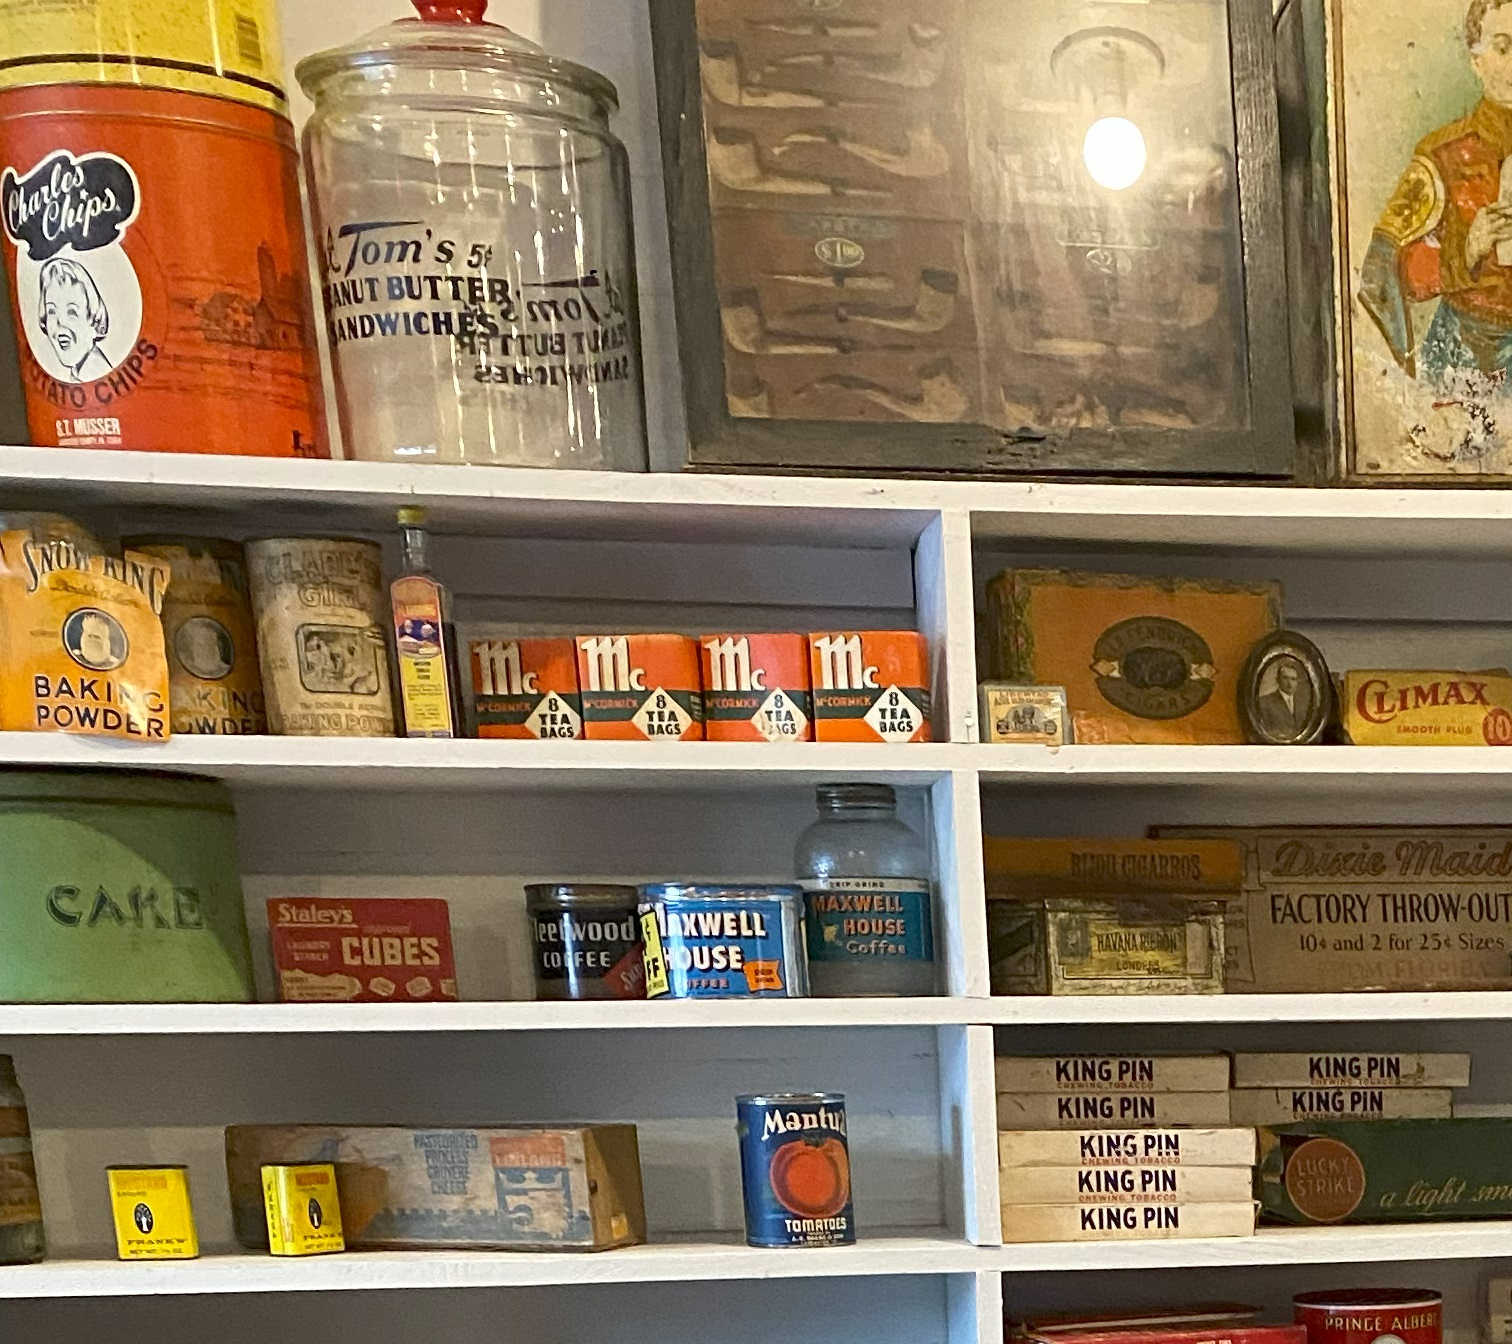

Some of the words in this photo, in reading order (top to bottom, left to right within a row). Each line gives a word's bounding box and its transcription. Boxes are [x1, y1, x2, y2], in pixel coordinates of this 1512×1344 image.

[9, 163, 84, 233] Charles
[339, 219, 456, 277] Tom's
[386, 275, 510, 304] BUTTER
[95, 338, 158, 405] CHIPS
[74, 418, 120, 435] MUSSER
[34, 675, 164, 713] BAKING
[656, 695, 667, 709] 8
[774, 694, 784, 709] 8
[889, 692, 899, 706] 8
[1356, 679, 1491, 723] CLIMAX
[549, 698, 559, 712] 8
[878, 707, 911, 720] TEA
[37, 705, 164, 738] POWDER
[539, 713, 571, 725] TEA
[645, 711, 678, 723] TEA
[765, 710, 795, 722] TEA
[540, 726, 574, 738] BAGS
[647, 723, 681, 735] BAGS
[879, 721, 914, 733] BAGS
[1446, 725, 1472, 734] PLUG
[1122, 853, 1201, 880] CIGARROS
[1271, 841, 1386, 878] Dixie
[1396, 841, 1512, 877] Maid
[46, 884, 205, 930] CAKE
[277, 903, 353, 924] Staley's
[811, 895, 904, 912] MAXWELL
[1270, 893, 1371, 925] FACTORY
[843, 918, 906, 936] HOUSE
[341, 937, 440, 966] CUBES
[846, 939, 906, 955] Coffee
[1097, 932, 1136, 952] HAVANA
[1300, 933, 1326, 952] 10¢
[1332, 934, 1365, 951] and
[1369, 935, 1381, 951] 2
[1389, 934, 1413, 951] for
[1420, 933, 1451, 951] 25¢
[1458, 932, 1504, 950] Sizes
[1055, 1060, 1111, 1082] KING
[1118, 1060, 1154, 1081] PIN
[1309, 1057, 1360, 1079] KING
[1366, 1056, 1400, 1078] PIN
[1105, 1081, 1154, 1089] TOBACCO
[1057, 1096, 1113, 1119] KING
[1120, 1096, 1155, 1118] PIN
[1291, 1090, 1345, 1113] KING
[1350, 1090, 1383, 1112] PIN
[1079, 1134, 1138, 1158] KING
[1143, 1134, 1180, 1156] PIN
[1134, 1156, 1181, 1164] TOBACCO
[1298, 1157, 1351, 1177] LUCKY
[1078, 1169, 1134, 1193] KING
[1140, 1169, 1177, 1192] PIN
[1298, 1179, 1356, 1197] STRIKE
[1129, 1192, 1177, 1201] TOBACCO
[1380, 1192, 1396, 1208] a
[1405, 1180, 1466, 1209] light
[784, 1217, 847, 1232] TOMATOES
[1080, 1207, 1137, 1231] KING
[1143, 1206, 1180, 1229] PIN
[1325, 1317, 1383, 1332] PRINCE
[1391, 1314, 1438, 1331] ALBERT
